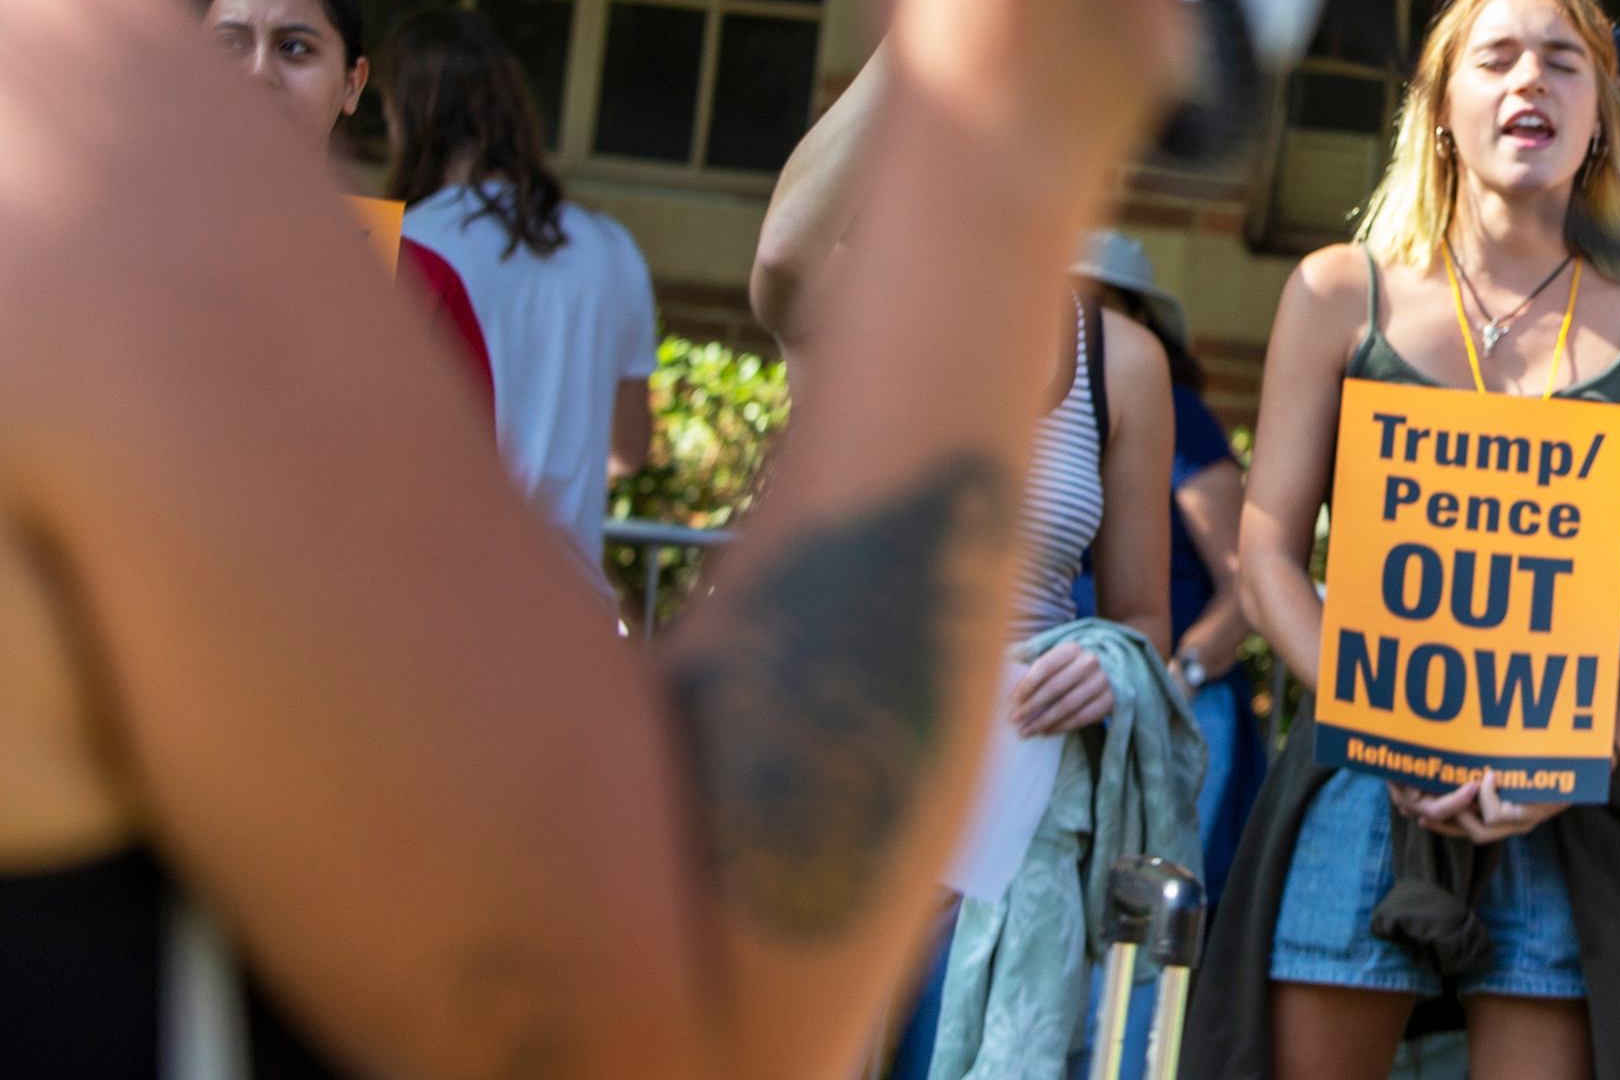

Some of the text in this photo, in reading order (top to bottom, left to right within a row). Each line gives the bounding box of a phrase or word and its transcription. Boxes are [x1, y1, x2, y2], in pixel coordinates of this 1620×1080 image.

[1373, 412, 1606, 486] Trump/
[1382, 475, 1582, 539] Pence
[1381, 542, 1574, 633] OUT
[1335, 627, 1599, 730] NOW!
